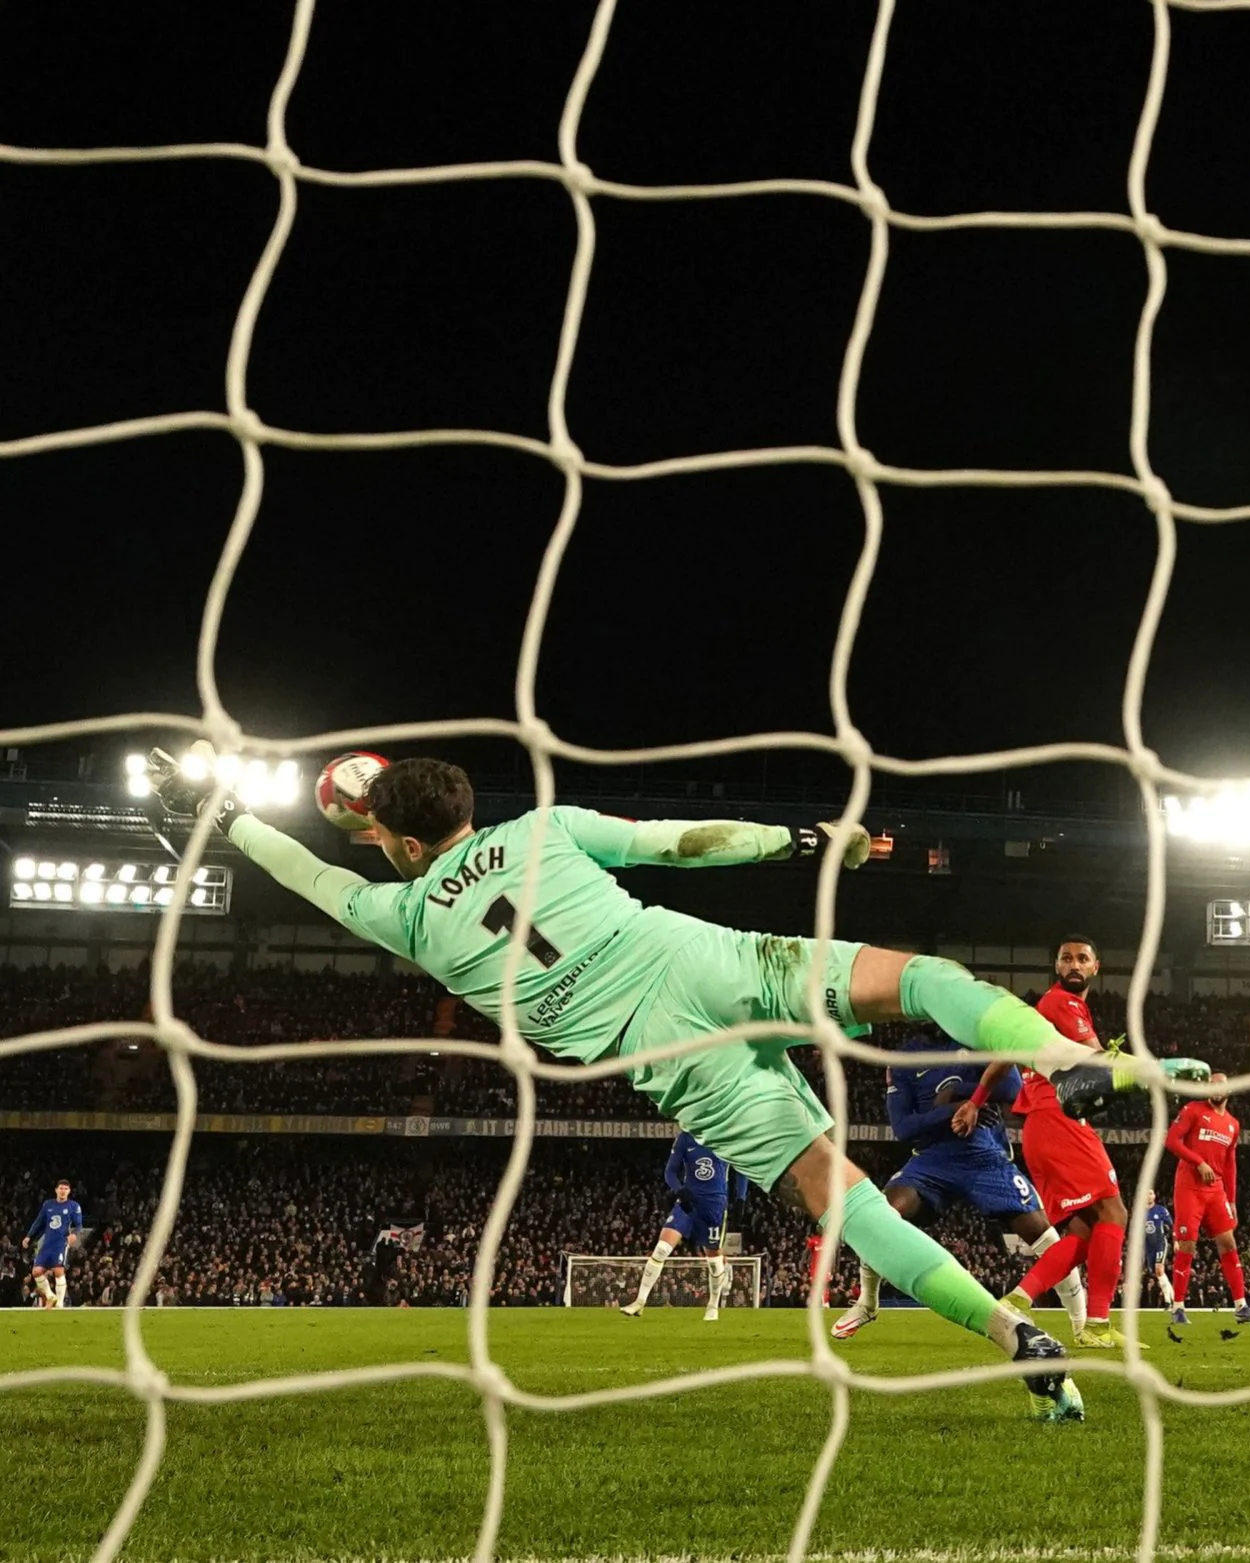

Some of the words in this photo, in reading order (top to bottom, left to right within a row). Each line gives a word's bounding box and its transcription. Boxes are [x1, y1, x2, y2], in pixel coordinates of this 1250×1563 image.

[427, 845, 505, 909] LOACH
[480, 894, 565, 971] 1
[1012, 1175, 1029, 1197] 9
[708, 1227, 720, 1240] 11
